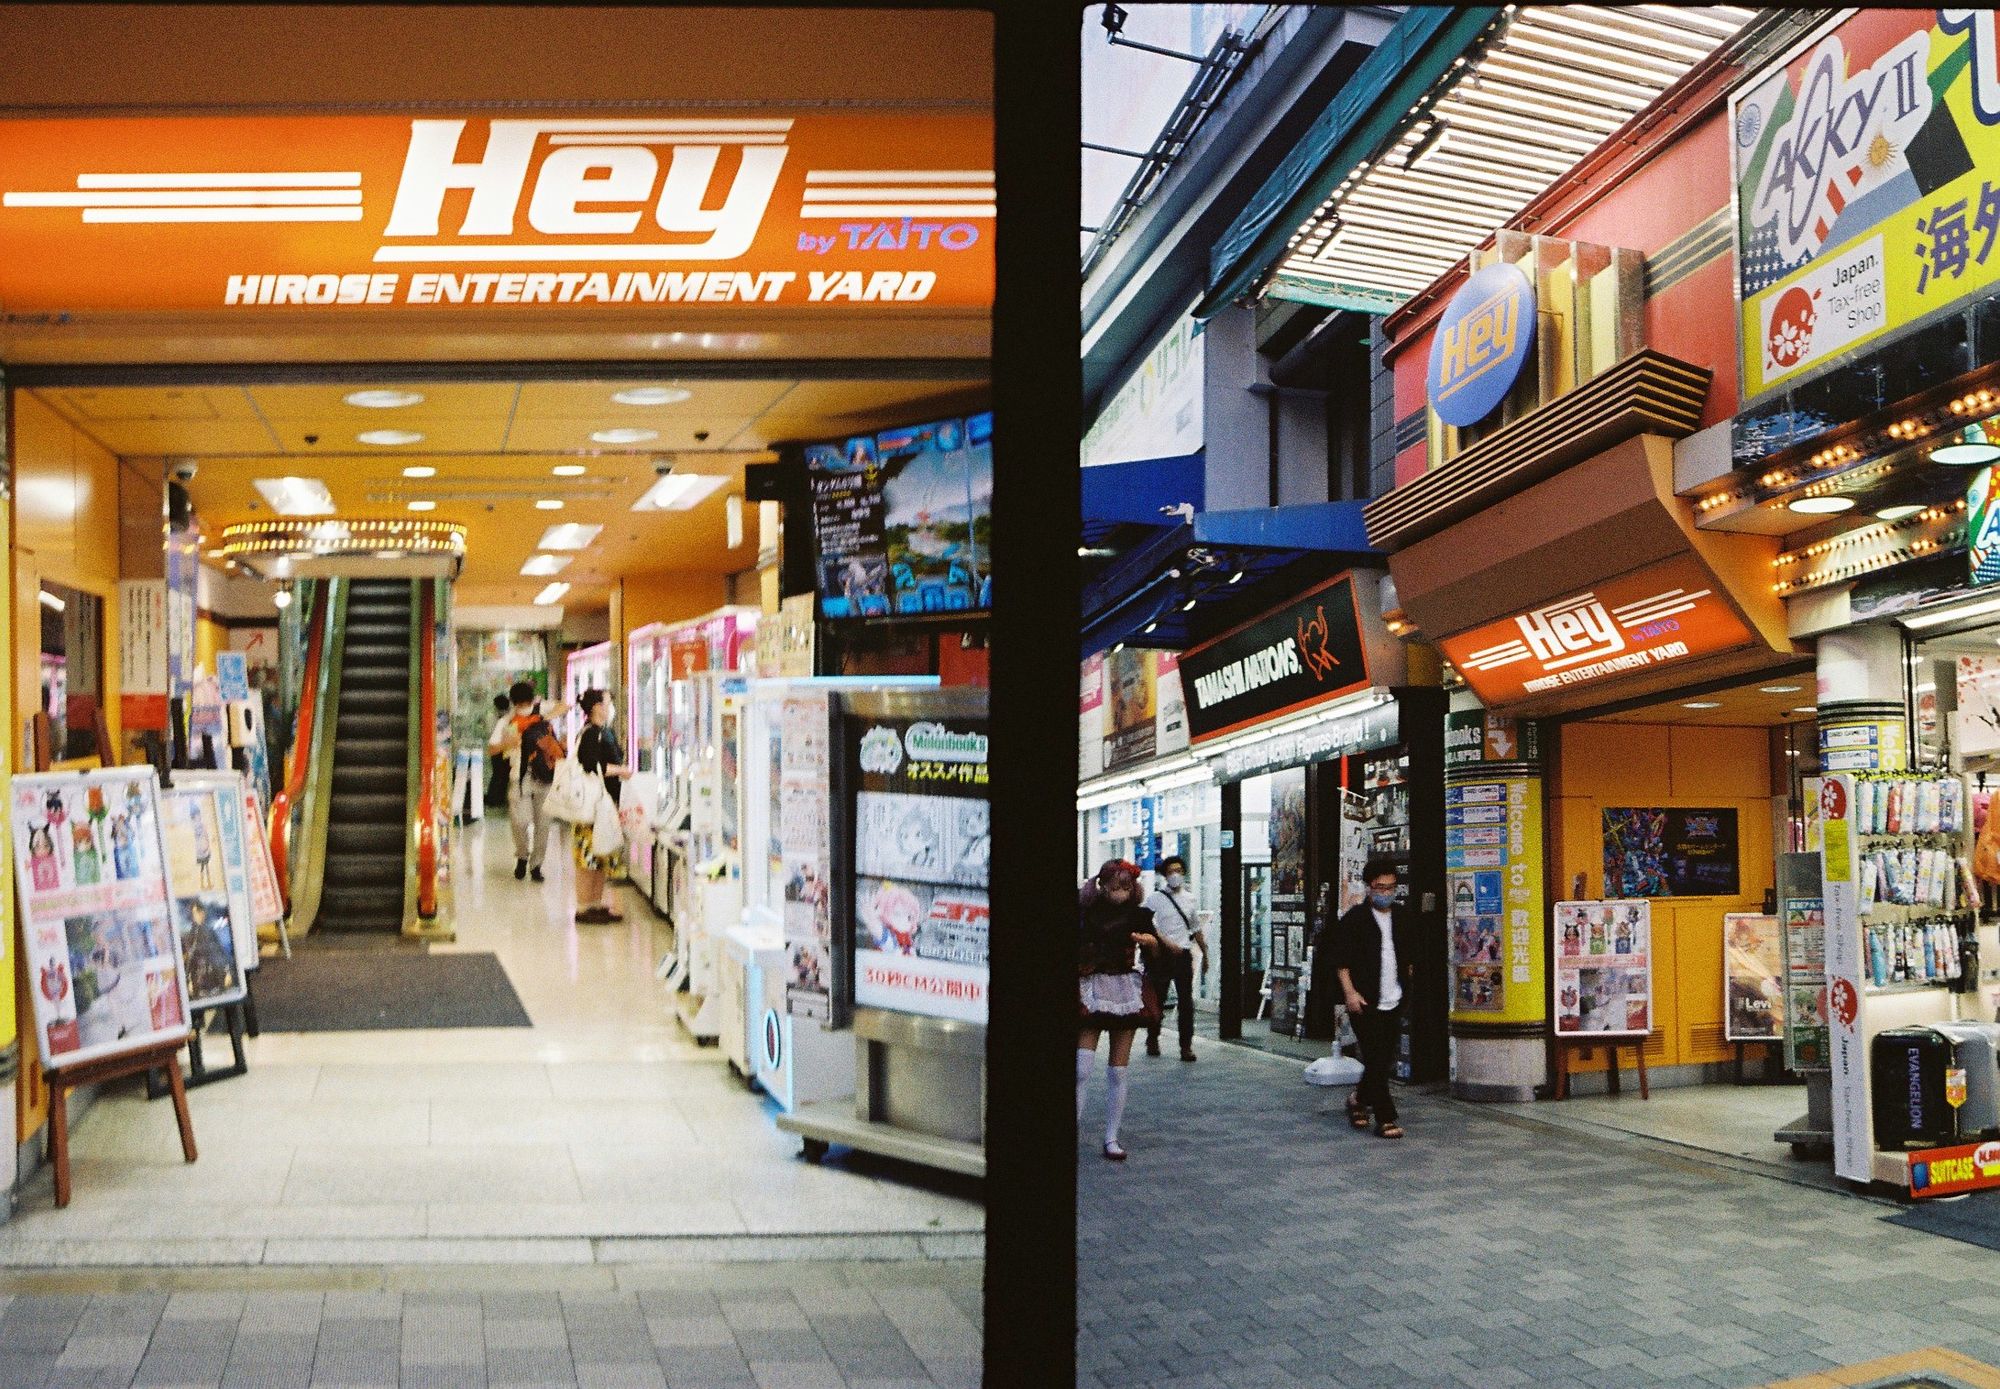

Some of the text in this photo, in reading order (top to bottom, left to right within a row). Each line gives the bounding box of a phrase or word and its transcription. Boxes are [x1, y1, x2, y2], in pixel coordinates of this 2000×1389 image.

[375, 118, 795, 263] Hey
[797, 216, 979, 255] by TAITO
[225, 270, 937, 305] HIROSE ENTERTAINMENT YARD
[1833, 254, 1879, 287] Japan.
[1828, 278, 1881, 316] Tax-free
[1849, 302, 1882, 329] Shop
[1438, 279, 1520, 402] Hey
[1514, 592, 1625, 670] Hey
[1561, 651, 1651, 685] ENTERTAINMENT
[1648, 641, 1689, 662] YARD
[1908, 1047, 1922, 1129] EVANGELION
[1930, 1157, 1975, 1185] SUITCASE
